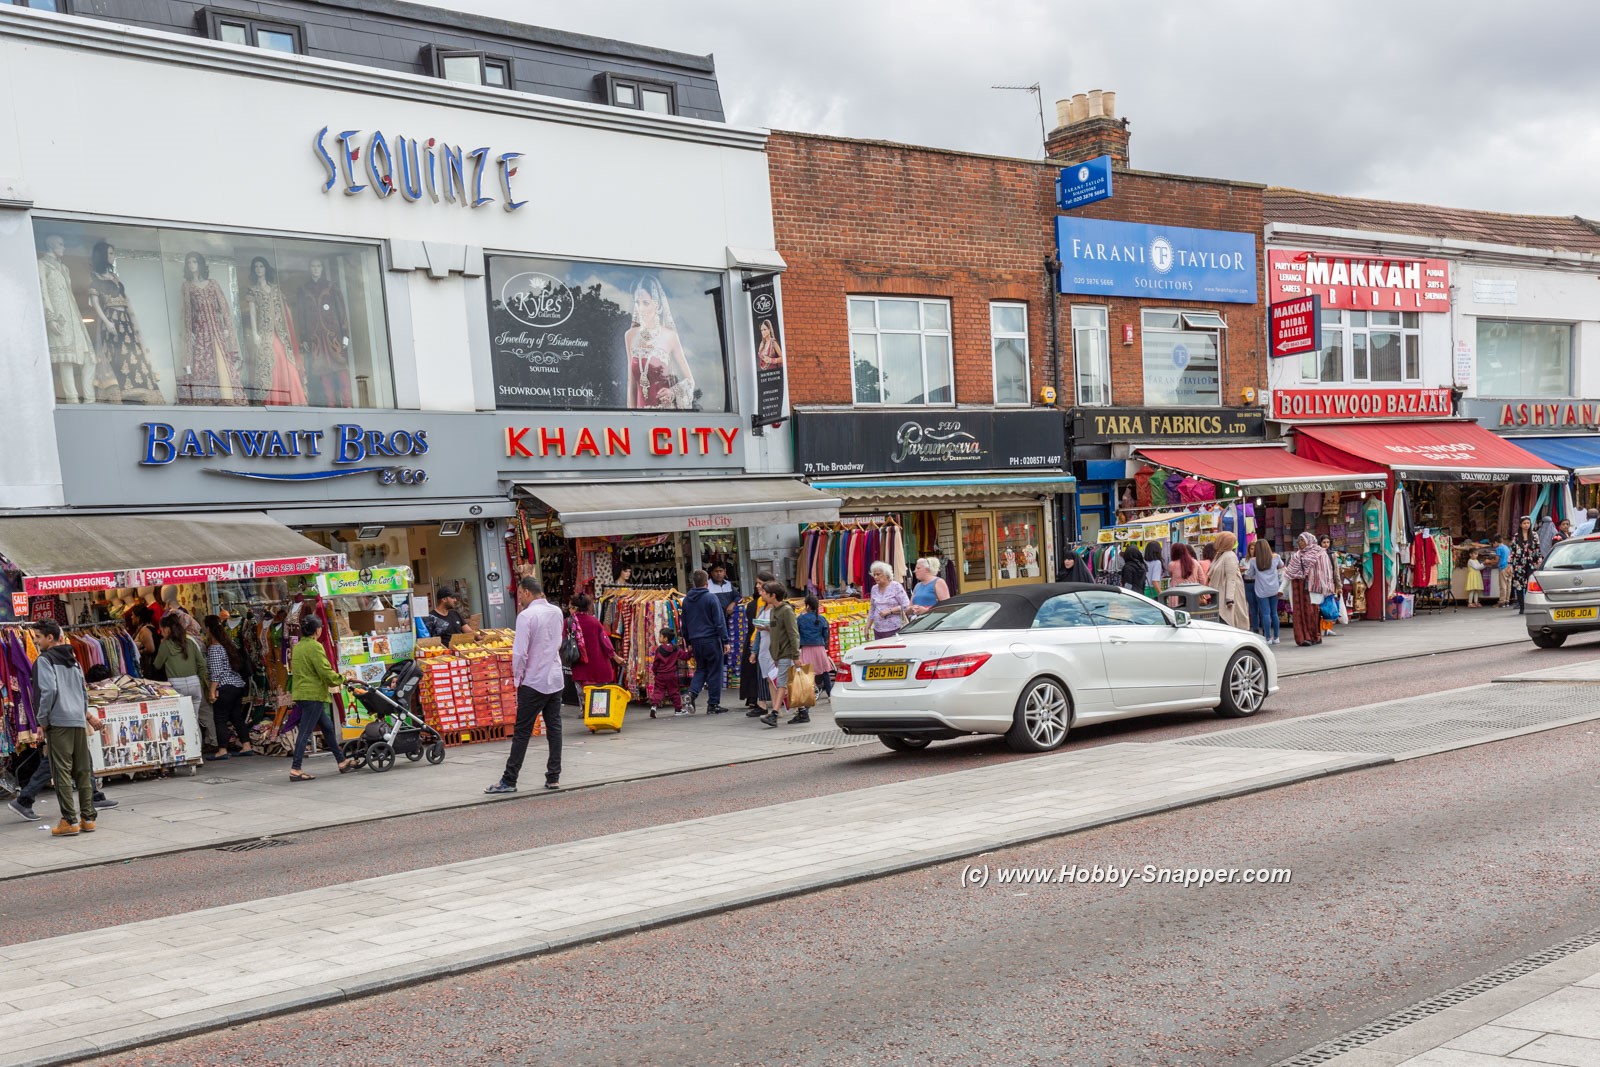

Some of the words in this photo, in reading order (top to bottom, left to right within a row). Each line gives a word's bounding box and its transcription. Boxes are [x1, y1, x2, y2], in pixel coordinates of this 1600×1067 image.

[1072, 238, 1144, 264] FARANI
[1178, 250, 1246, 271] TAYLOR
[1275, 262, 1291, 271] PARTY
[1291, 264, 1306, 272] WEAR
[1305, 256, 1420, 289] MAKKAH
[1135, 277, 1193, 291] SOLICITORS
[1281, 285, 1300, 293] SAREES
[514, 289, 562, 318] Kyles
[1274, 301, 1312, 318] MAKKAH
[1281, 316, 1305, 329] BRIDAL
[1279, 325, 1307, 338] GALLERY
[495, 331, 535, 348] Jewellery
[537, 333, 547, 348] of
[548, 334, 588, 347] Distinction
[1184, 376, 1213, 385] TAYLOR
[499, 385, 550, 396] SHOWROOM
[553, 387, 566, 396] 1ST
[568, 388, 594, 397] FLOOR
[1281, 394, 1382, 414] BOLLYWOOD
[1388, 394, 1448, 412] BAZAAR
[1499, 404, 1600, 426] ASHYAN
[1095, 416, 1144, 435] TARA
[1150, 416, 1222, 434] FABRICS
[139, 422, 324, 465] BANWAIT
[332, 424, 429, 464] BROS
[505, 427, 630, 457] KHAN
[649, 427, 738, 456] CITY
[1384, 443, 1476, 453] BOLLYWOOD
[1422, 452, 1476, 460] BAZAR
[805, 464, 815, 473] 79,
[816, 463, 830, 471] The
[831, 462, 864, 472] Broadway
[379, 470, 396, 485] &
[1274, 485, 1294, 494] TARA
[1294, 484, 1321, 492] FABRICS
[688, 517, 712, 527] Khan
[715, 516, 732, 527] City
[146, 571, 170, 580] SOHA
[172, 566, 224, 578] COLLECTION
[256, 564, 278, 574] 07494
[281, 564, 295, 572] 253
[296, 562, 310, 571] 909
[38, 579, 72, 590] FASHION
[73, 576, 110, 587] DESIGNER
[338, 579, 360, 588] Sweet
[379, 576, 393, 585] Cart
[13, 596, 26, 604] SALE
[35, 603, 50, 611] SALE
[34, 611, 52, 619] £9.99
[1556, 610, 1575, 618] SU06
[869, 668, 886, 678] BG13
[888, 667, 904, 677] NHB
